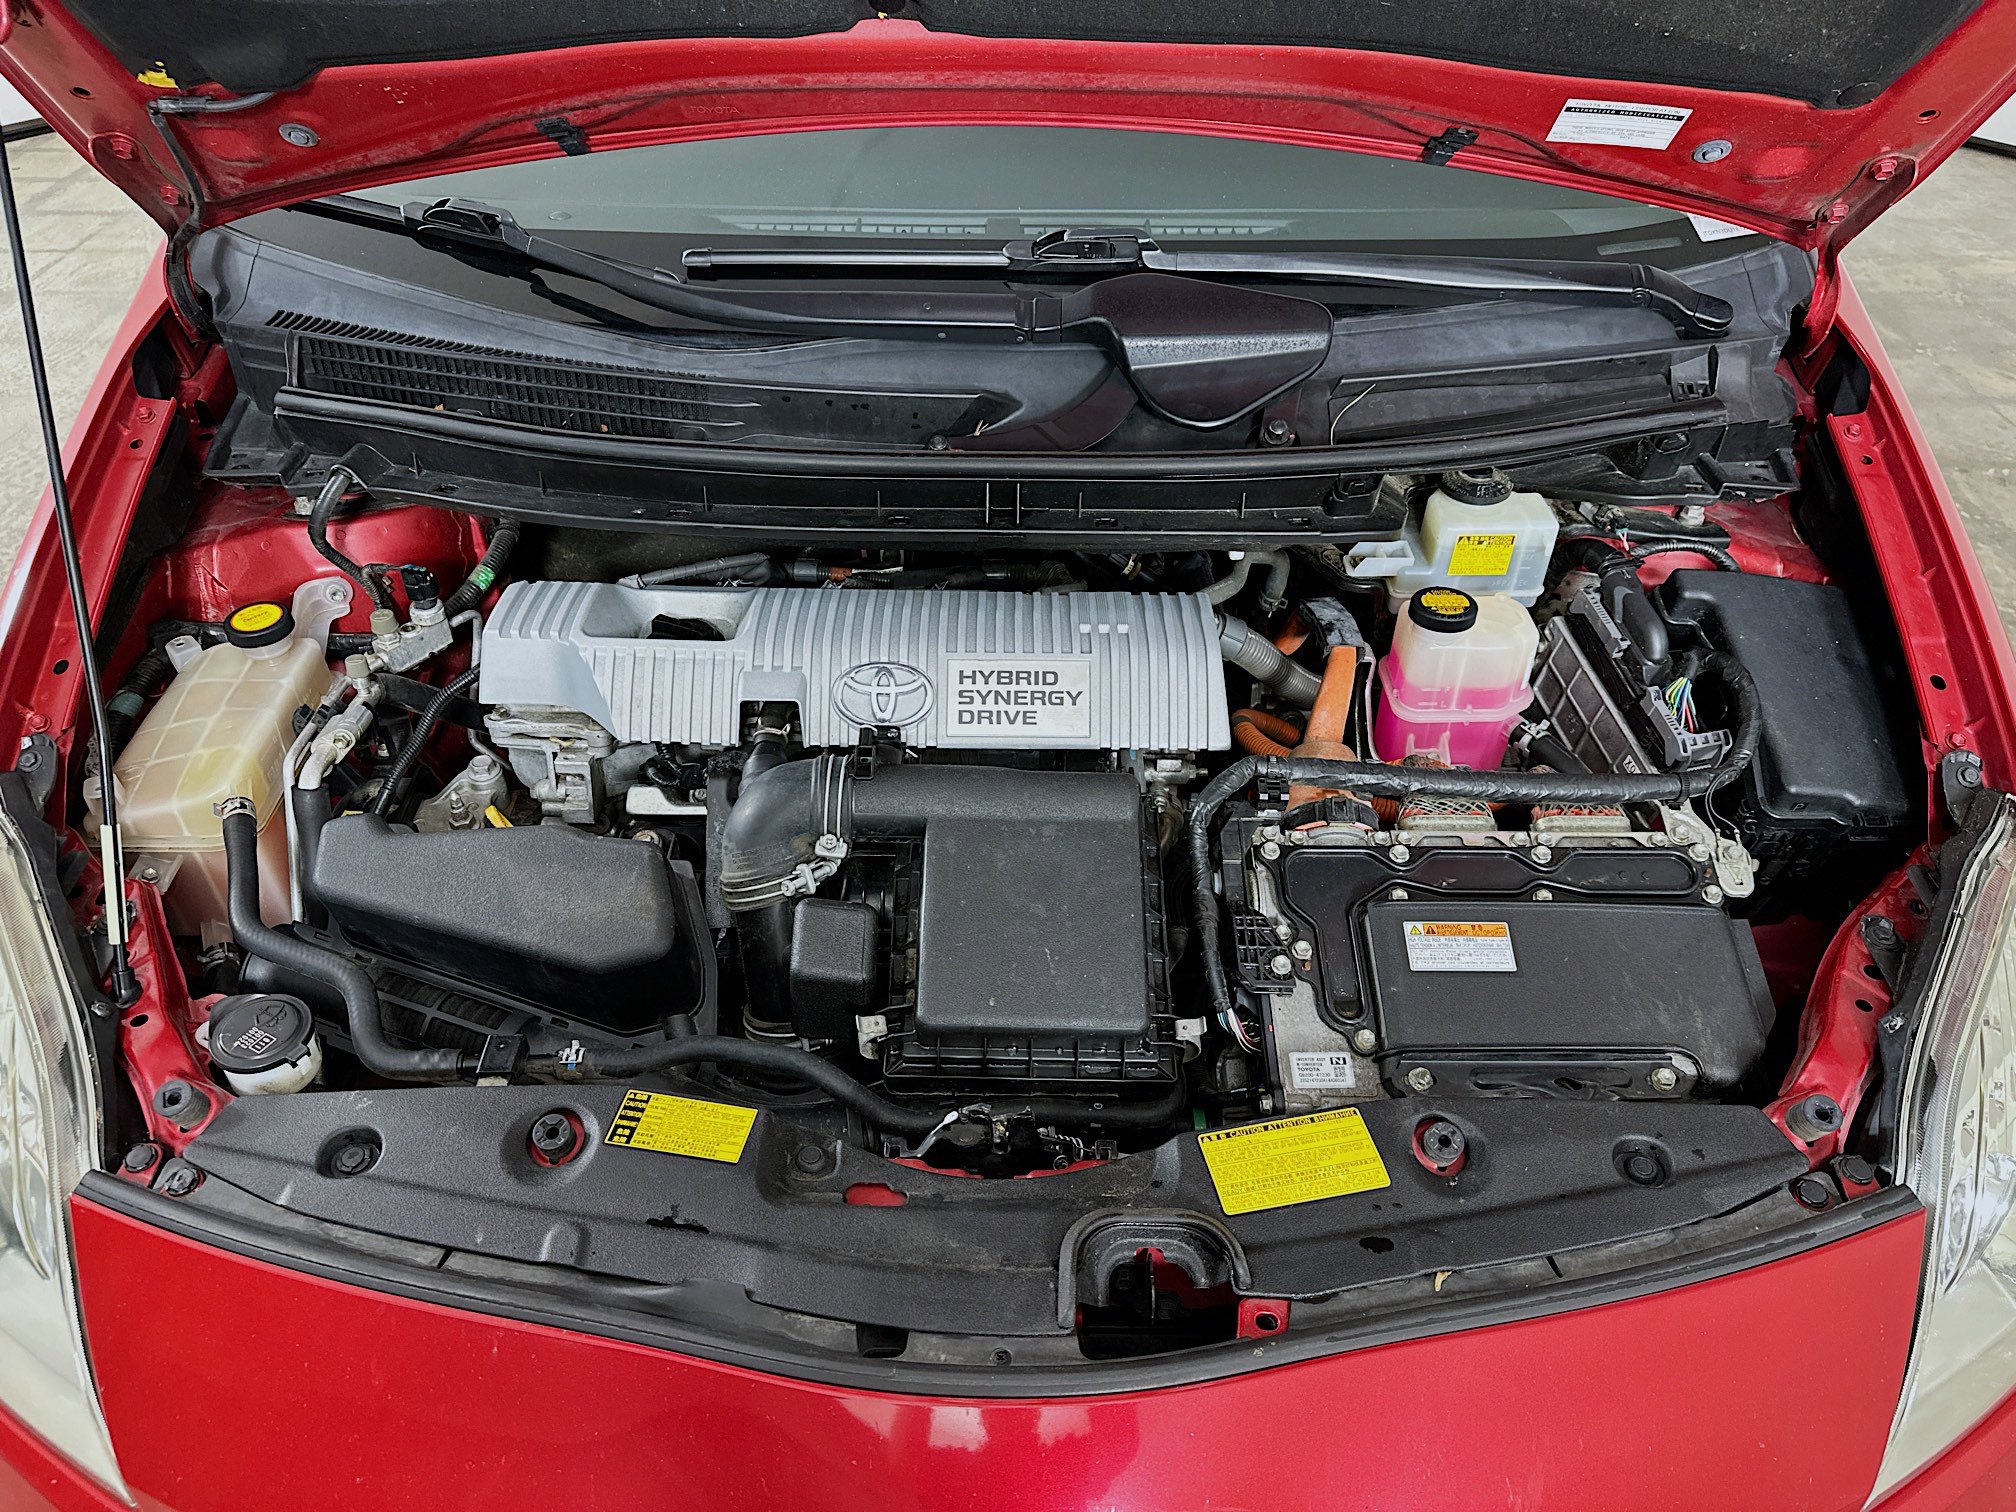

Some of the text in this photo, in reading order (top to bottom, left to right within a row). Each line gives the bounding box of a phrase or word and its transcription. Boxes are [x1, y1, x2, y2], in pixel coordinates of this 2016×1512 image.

[690, 105, 740, 114] TOYOTA
[1570, 107, 1616, 115] AUTHORIZED
[1619, 110, 1679, 120] MODIFICATIONS
[958, 670, 1059, 686] HYBRID
[958, 690, 1084, 706] SYNERGY
[958, 710, 1038, 725] DRIVE
[625, 1100, 648, 1108] CAUTION
[620, 1109, 644, 1118] ATTENTION
[1230, 1127, 1265, 1137] CAUTION
[1268, 1117, 1312, 1131] ATTENTION
[1315, 1110, 1357, 1123] ВНИМАНИЕ
